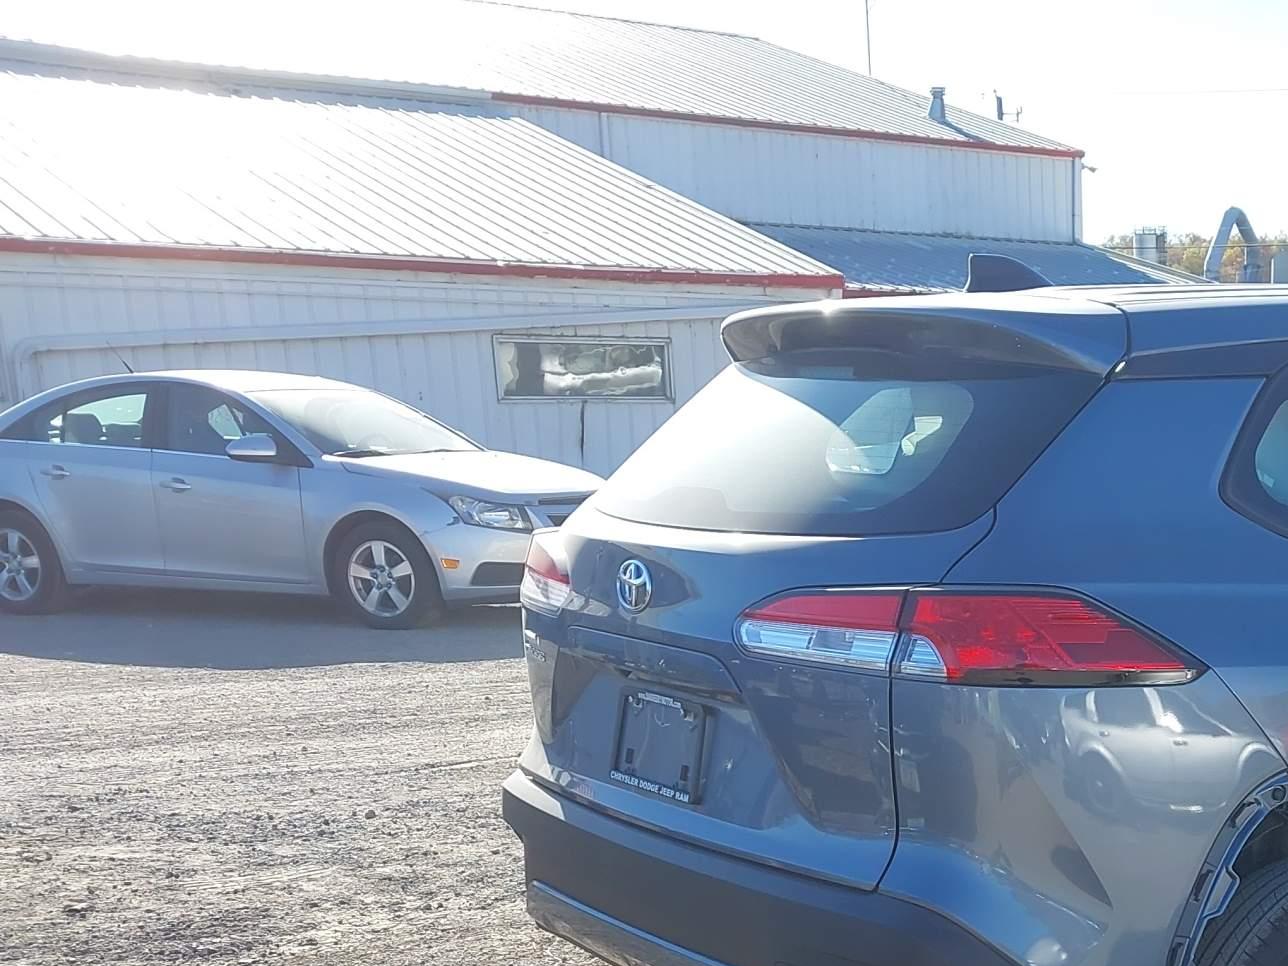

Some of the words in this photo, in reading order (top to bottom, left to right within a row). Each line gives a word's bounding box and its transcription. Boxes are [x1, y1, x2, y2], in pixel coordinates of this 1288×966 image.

[610, 770, 639, 787] CHRYSLER
[639, 780, 659, 793] DODGE
[659, 785, 675, 798] JEEP
[675, 791, 690, 803] RAM
